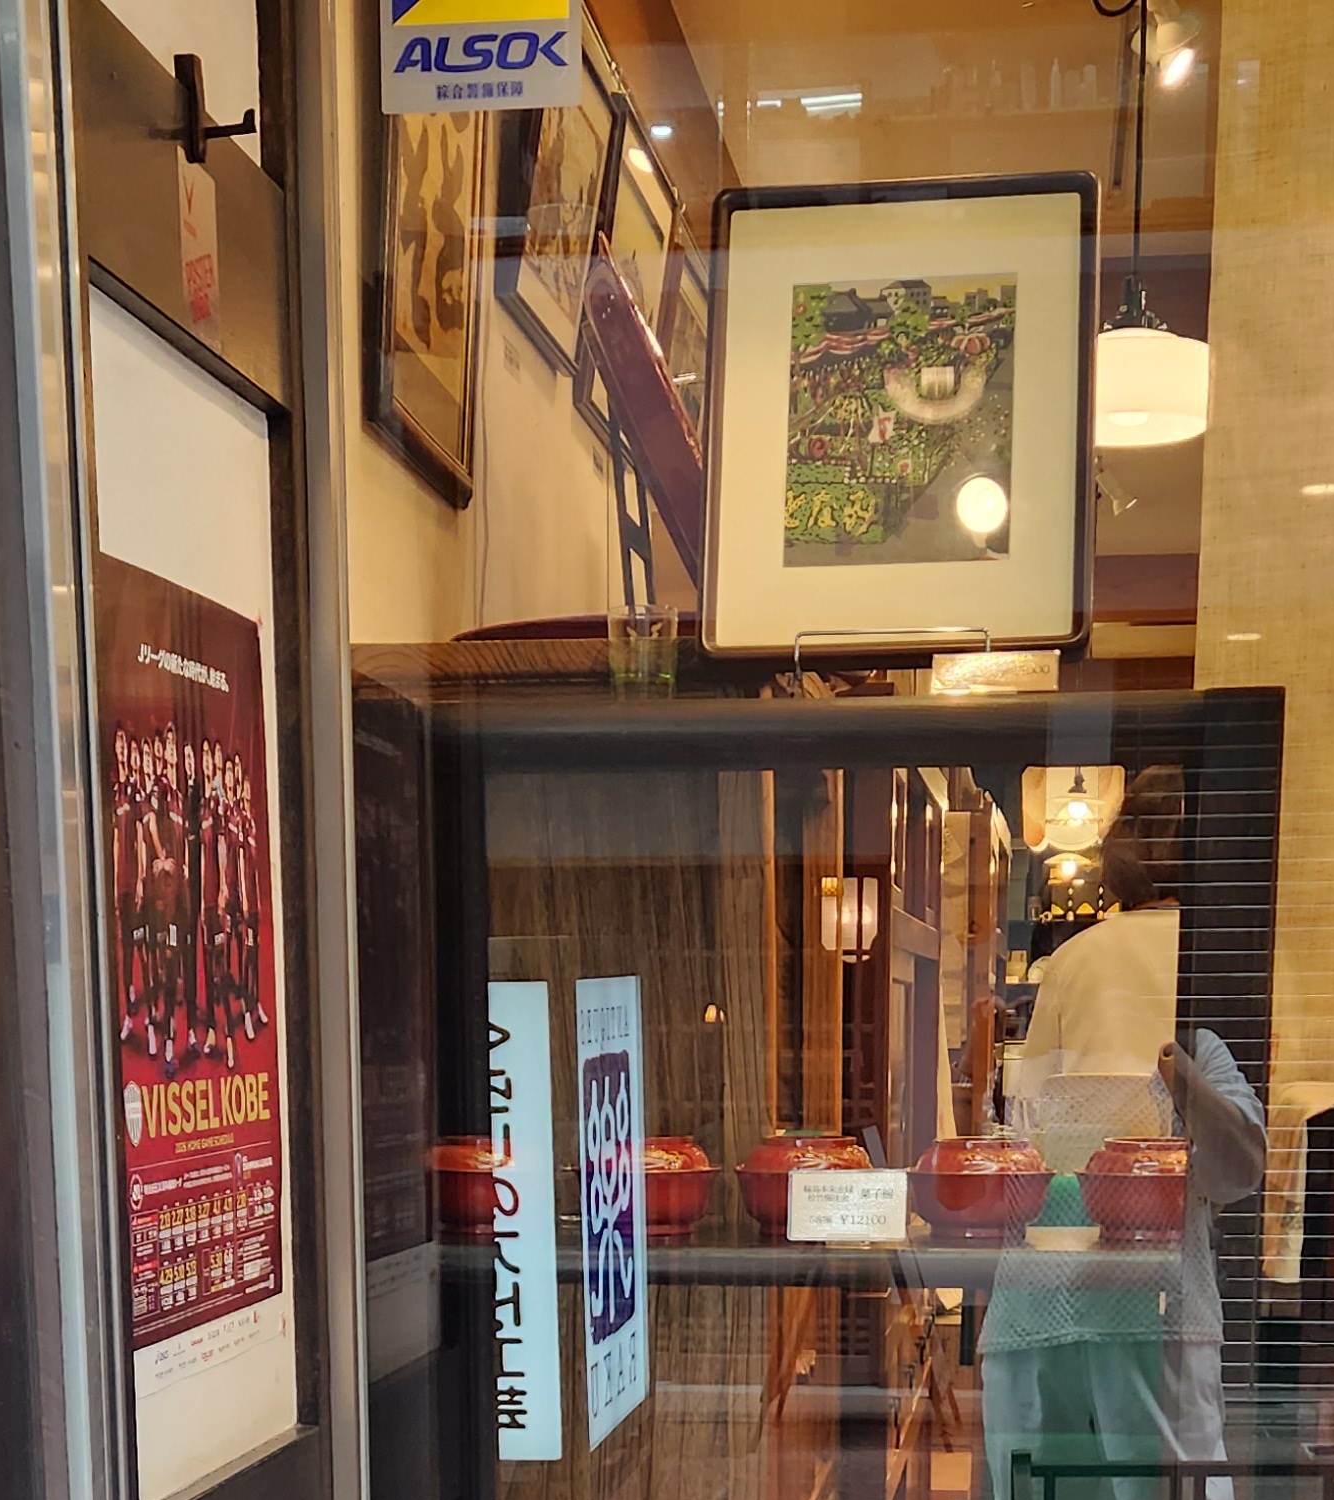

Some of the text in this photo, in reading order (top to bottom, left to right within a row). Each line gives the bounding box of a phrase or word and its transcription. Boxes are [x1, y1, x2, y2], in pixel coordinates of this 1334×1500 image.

[394, 31, 568, 73] ALSOK
[141, 1072, 271, 1138] VISSEL KOBE
